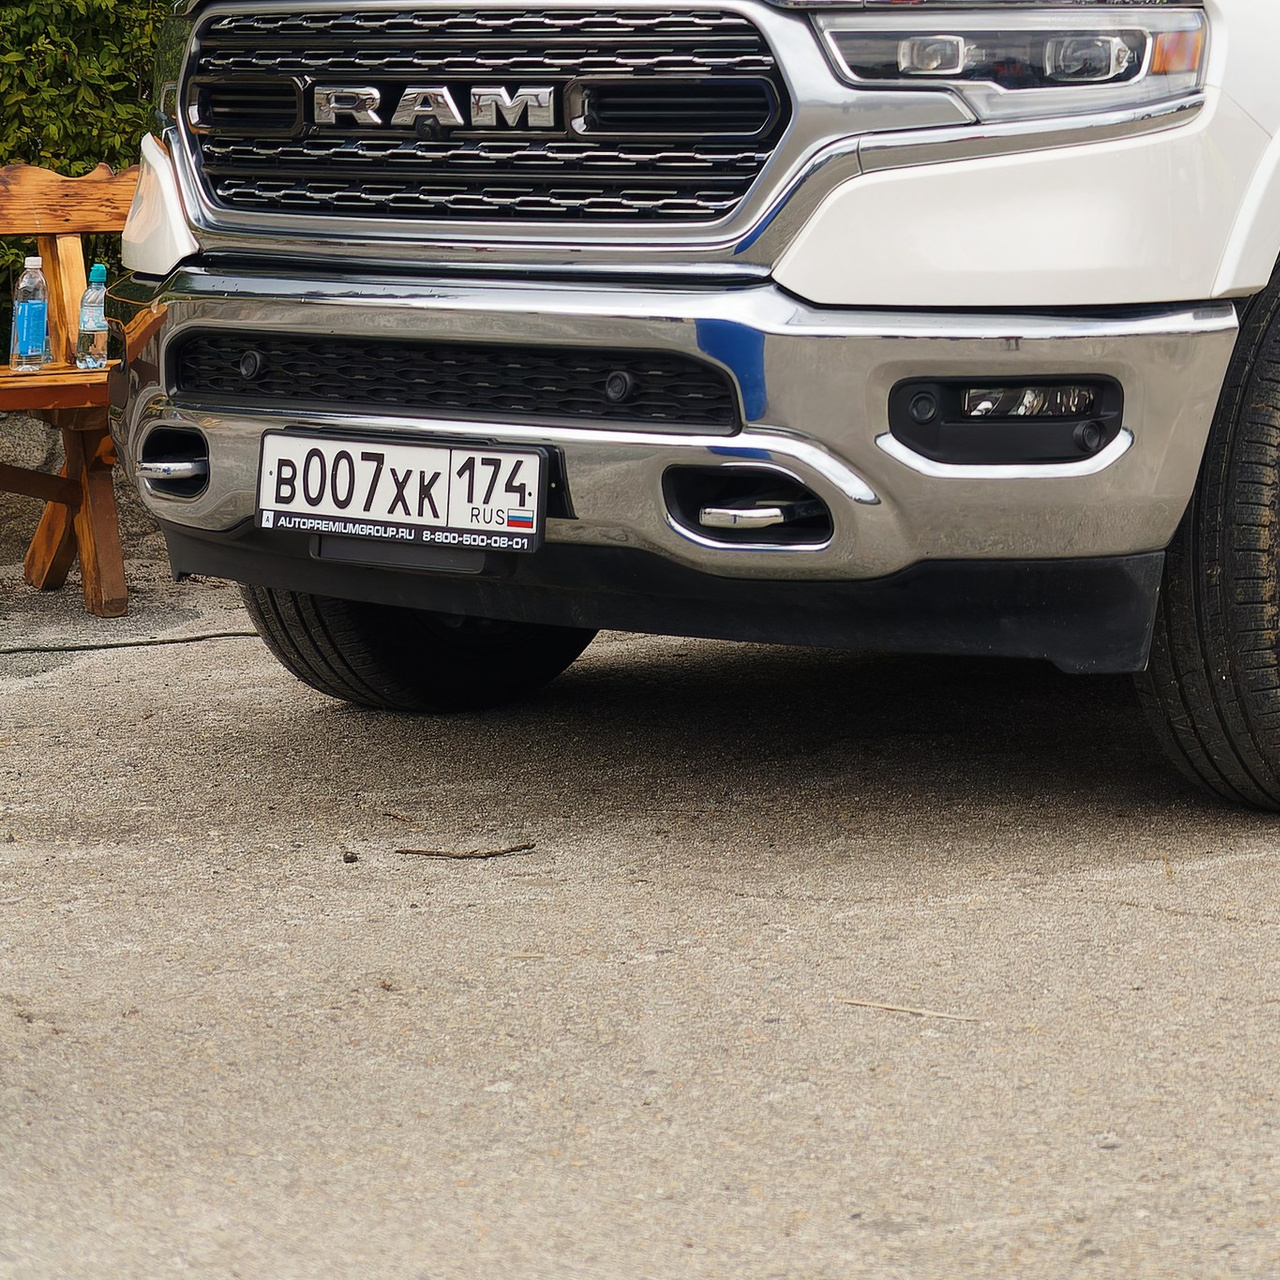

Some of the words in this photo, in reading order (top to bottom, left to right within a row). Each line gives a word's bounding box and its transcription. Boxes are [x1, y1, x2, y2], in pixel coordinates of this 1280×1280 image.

[314, 85, 555, 127] RAM
[456, 456, 527, 507] 174
[277, 516, 415, 539] AUTOPREMIUMGROUP.RU
[422, 530, 528, 549] 8-800-500-08-01
[470, 507, 505, 525] RUS
